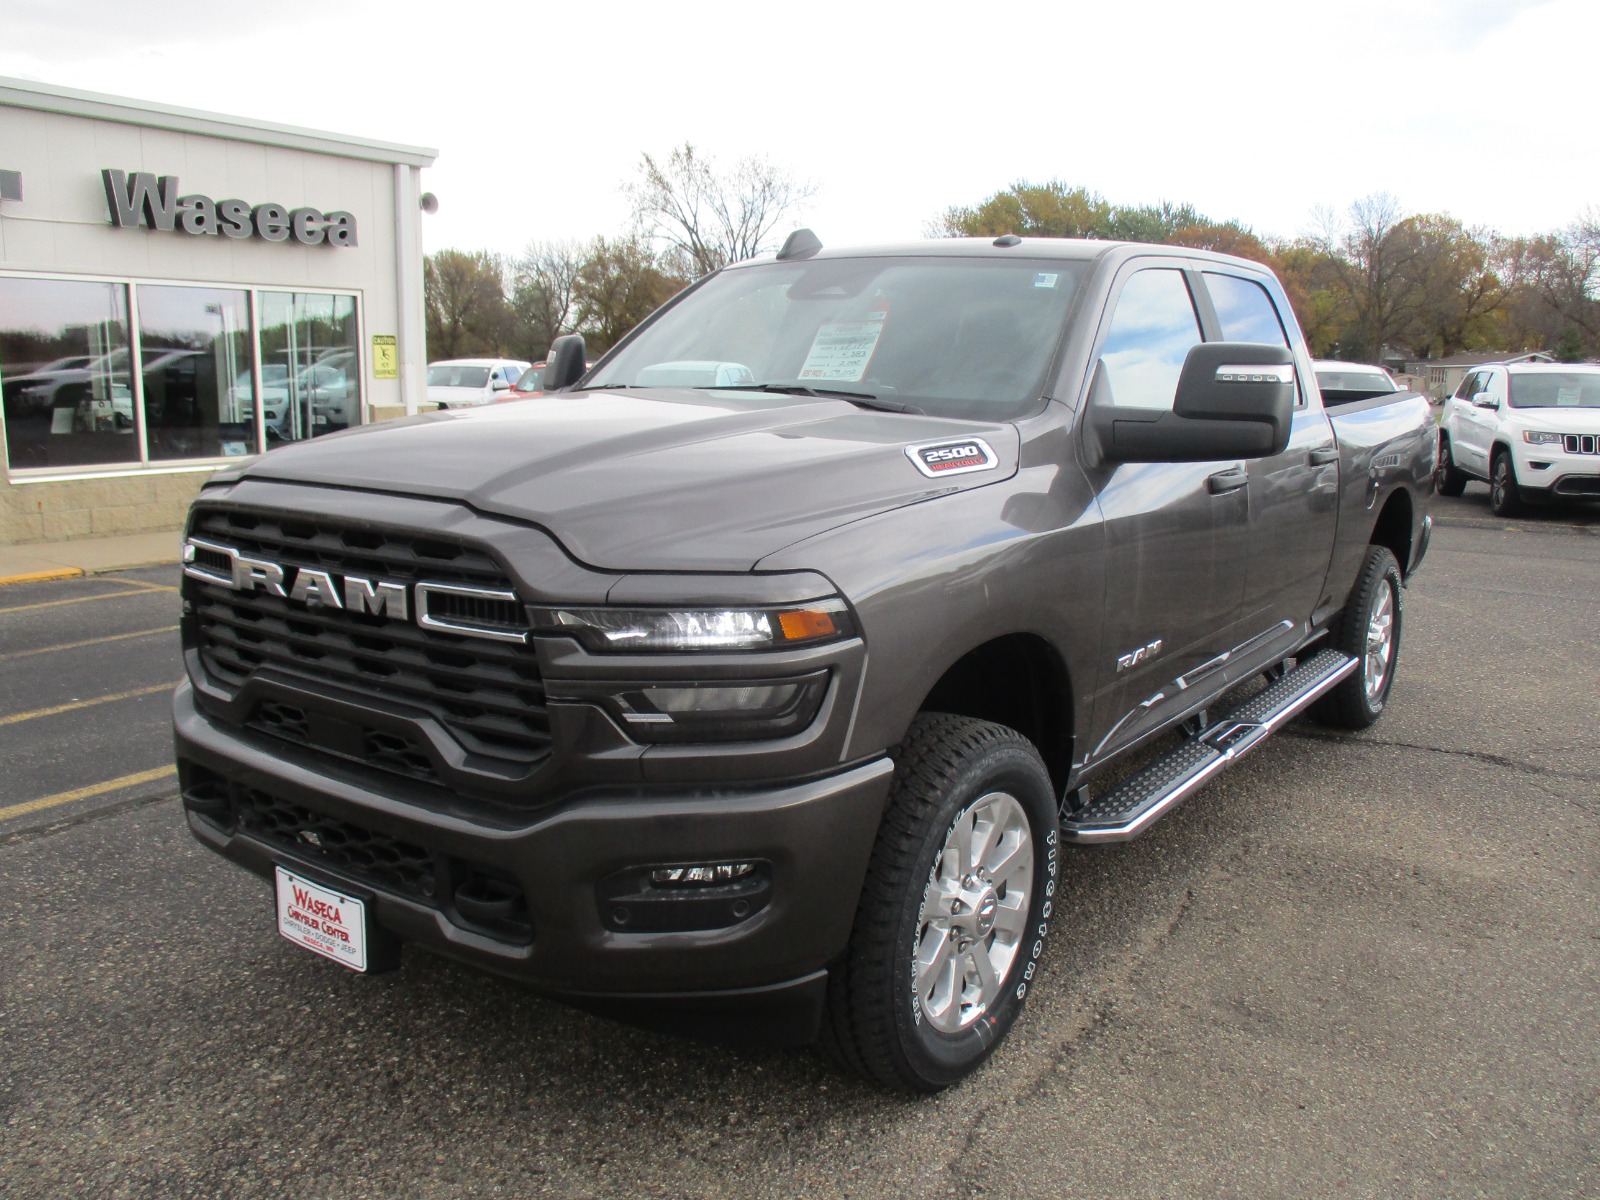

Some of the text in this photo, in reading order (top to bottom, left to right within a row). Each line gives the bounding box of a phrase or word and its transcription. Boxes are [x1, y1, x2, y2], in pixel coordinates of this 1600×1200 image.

[101, 169, 358, 247] Waseca
[925, 446, 978, 462] 2500
[931, 458, 984, 471] HEAVY DUTY
[237, 557, 408, 620] RAM
[1116, 640, 1162, 672] RAM
[292, 885, 342, 924] WASECA
[1016, 829, 1057, 1000] Firestone
[284, 917, 357, 955] CHRYSLER DODGE JEEP
[288, 905, 351, 944] CHRYSLER CENTER
